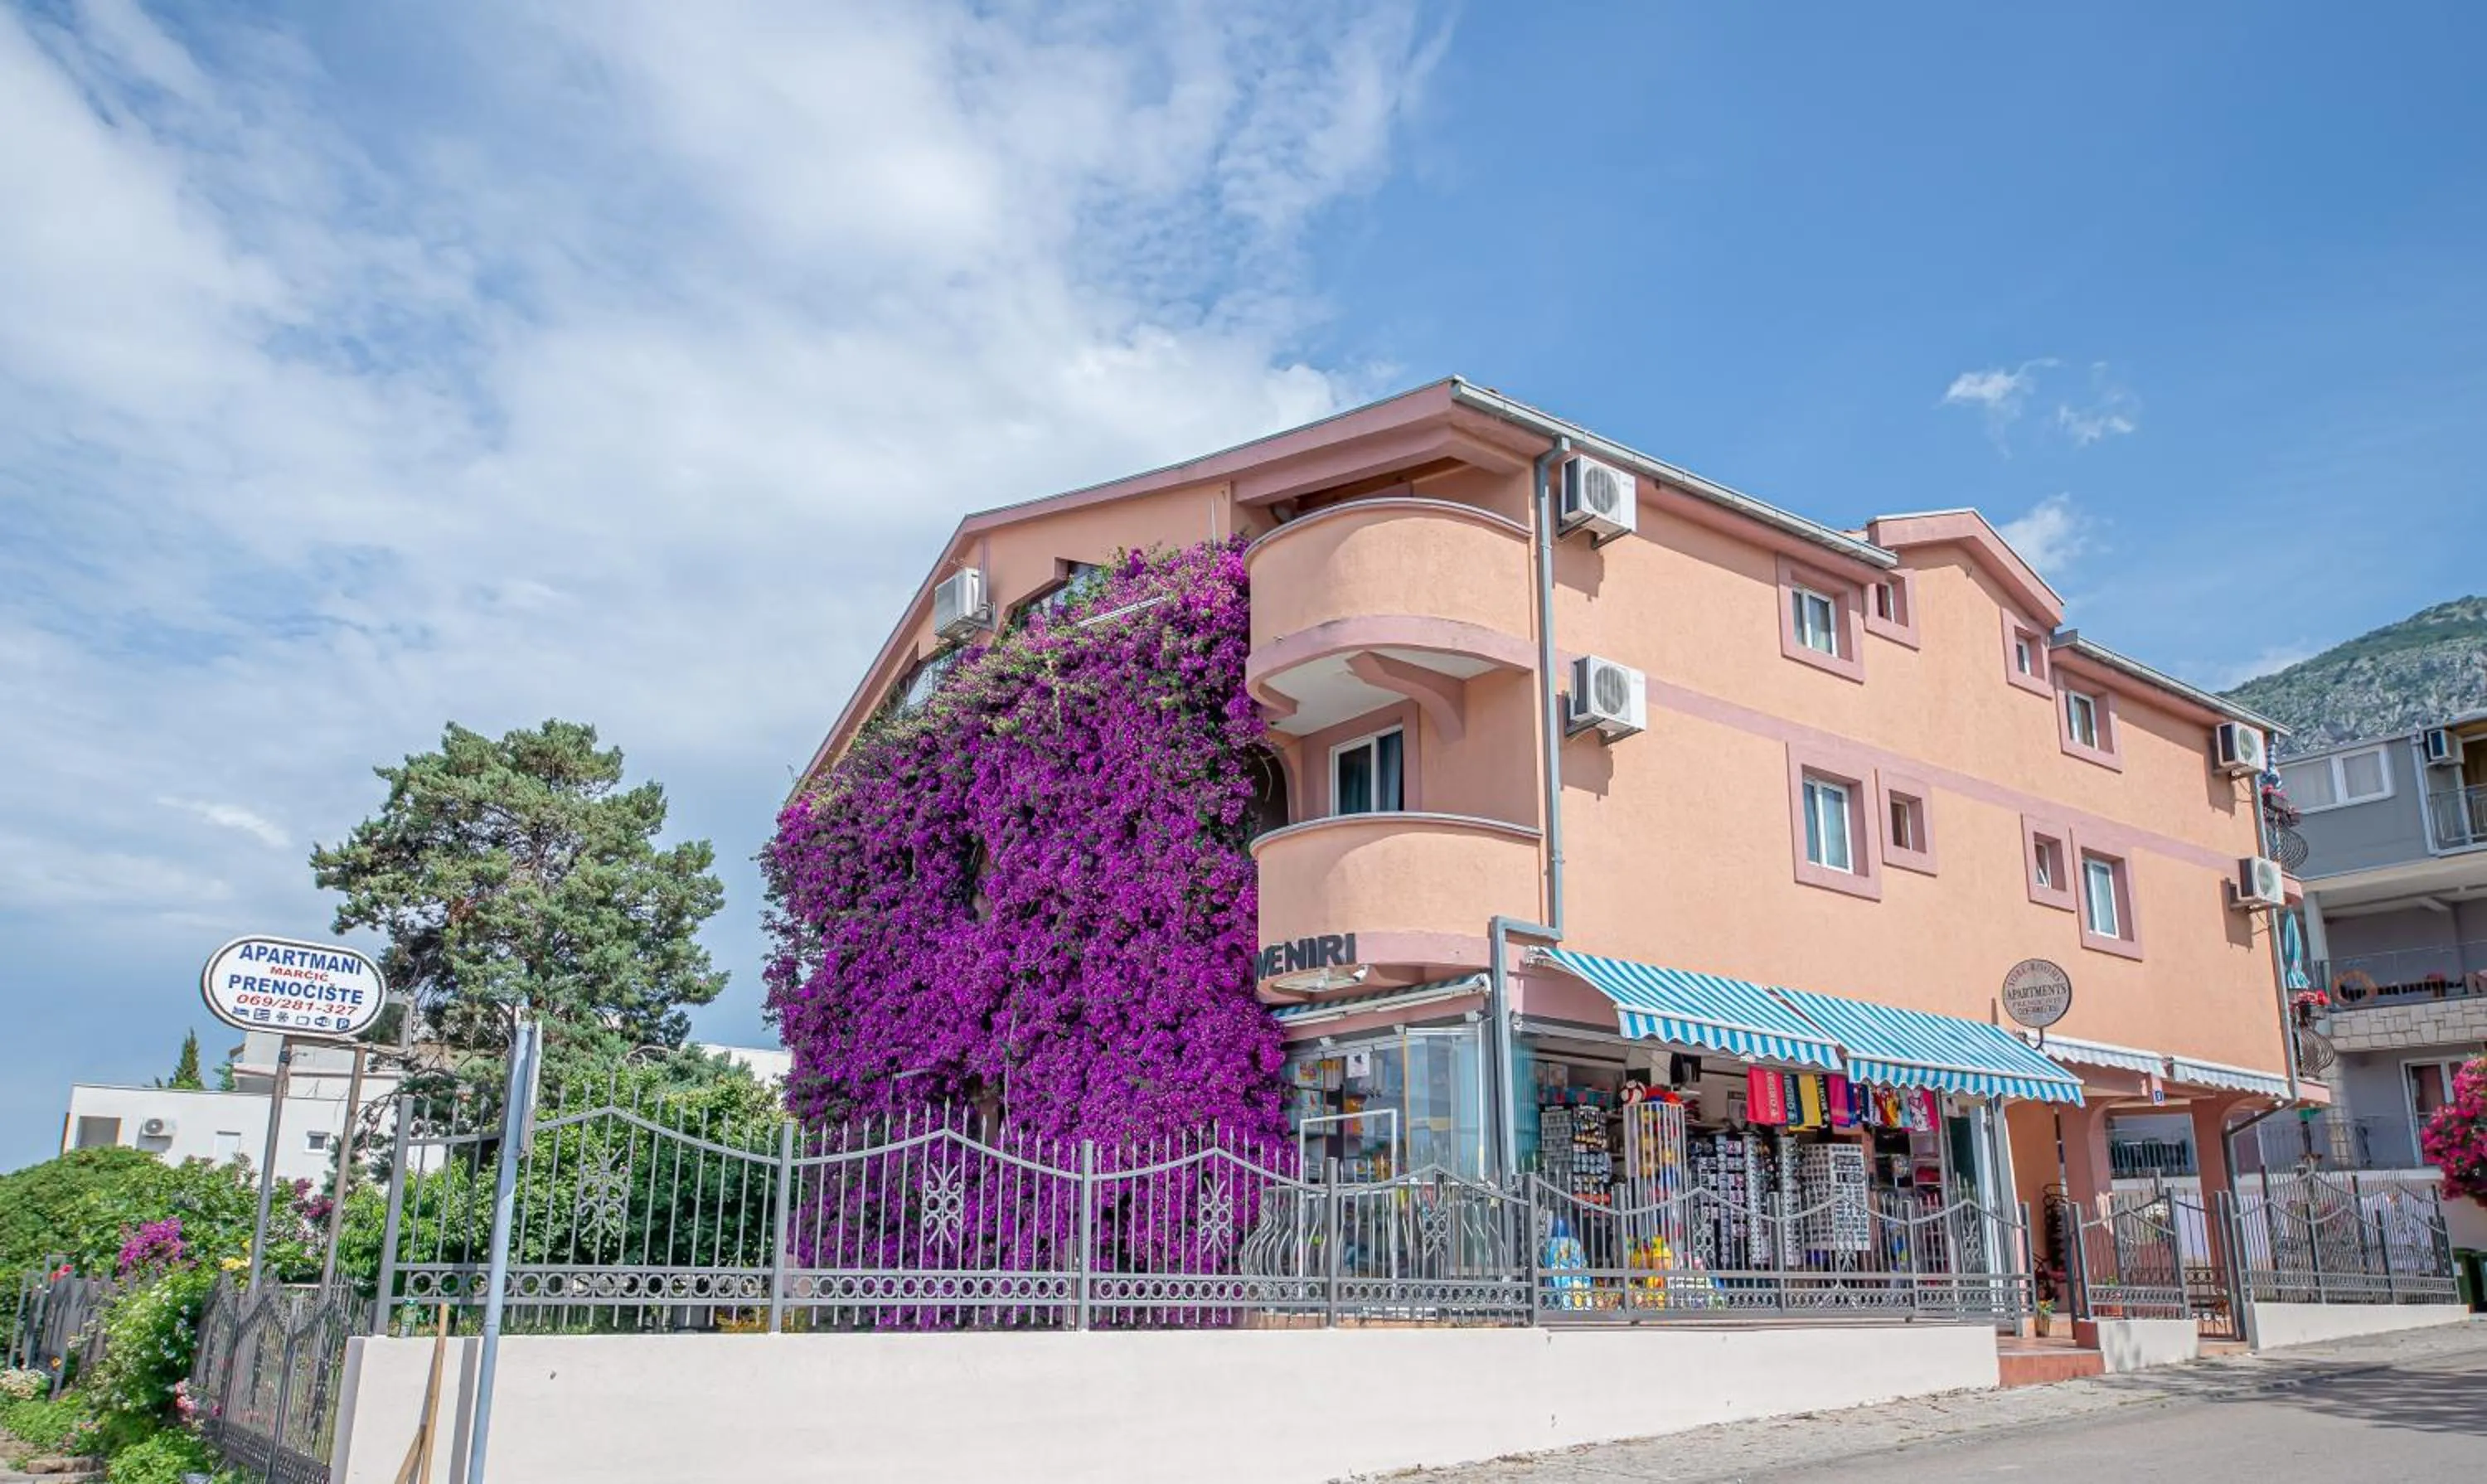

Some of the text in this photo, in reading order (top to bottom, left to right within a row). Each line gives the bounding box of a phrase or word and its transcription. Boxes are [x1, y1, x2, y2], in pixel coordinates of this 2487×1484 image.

[239, 944, 362, 975] APARTMANI
[228, 974, 364, 1005] PRENOĆIŠTE
[236, 994, 358, 1016] 069/281-327
